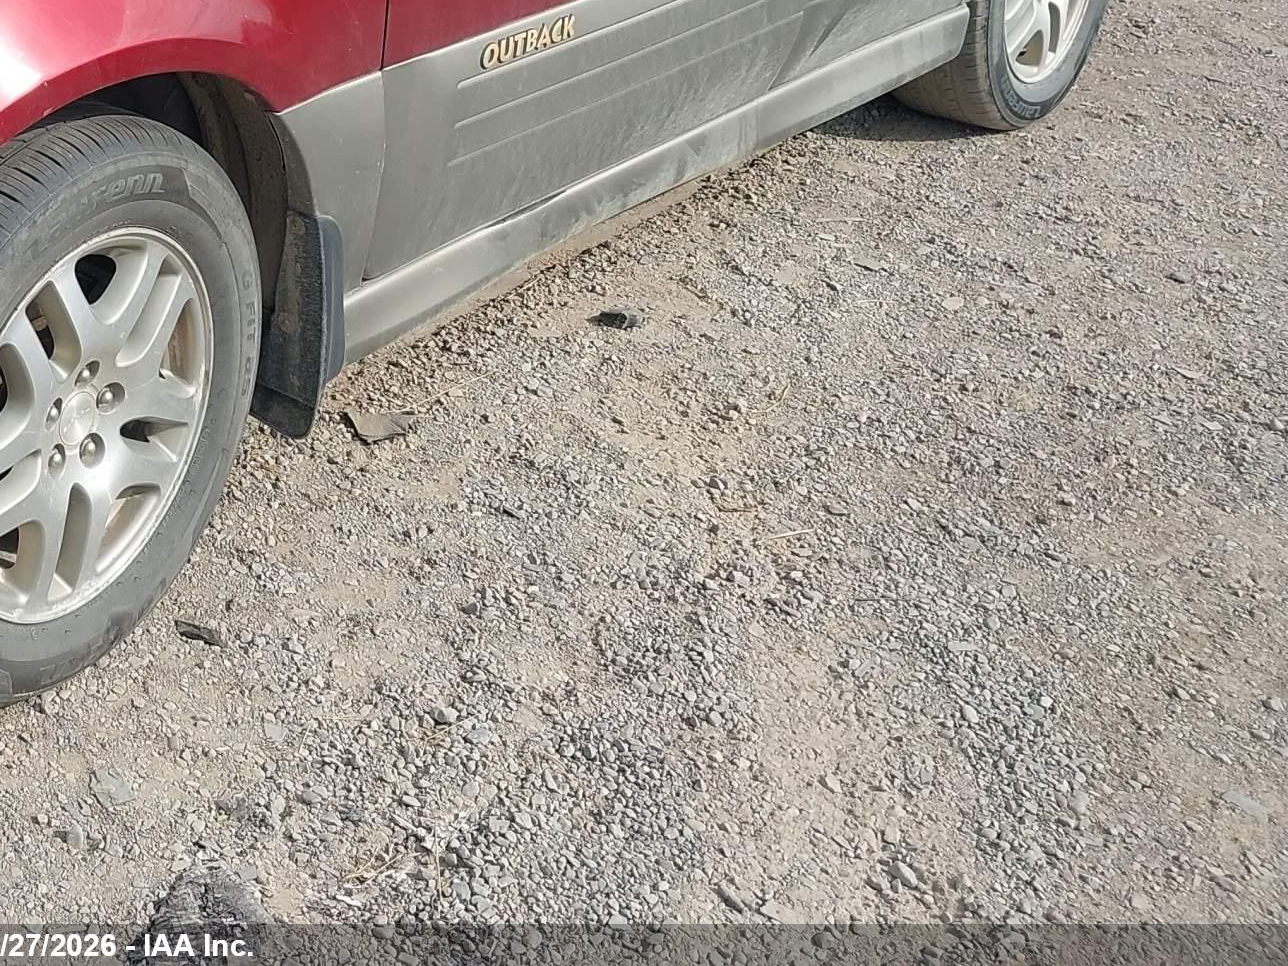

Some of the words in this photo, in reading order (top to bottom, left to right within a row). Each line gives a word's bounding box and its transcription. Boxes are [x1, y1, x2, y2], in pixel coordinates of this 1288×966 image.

[480, 13, 576, 70] OUTBACK
[241, 269, 256, 291] G
[245, 299, 257, 345] FIT
